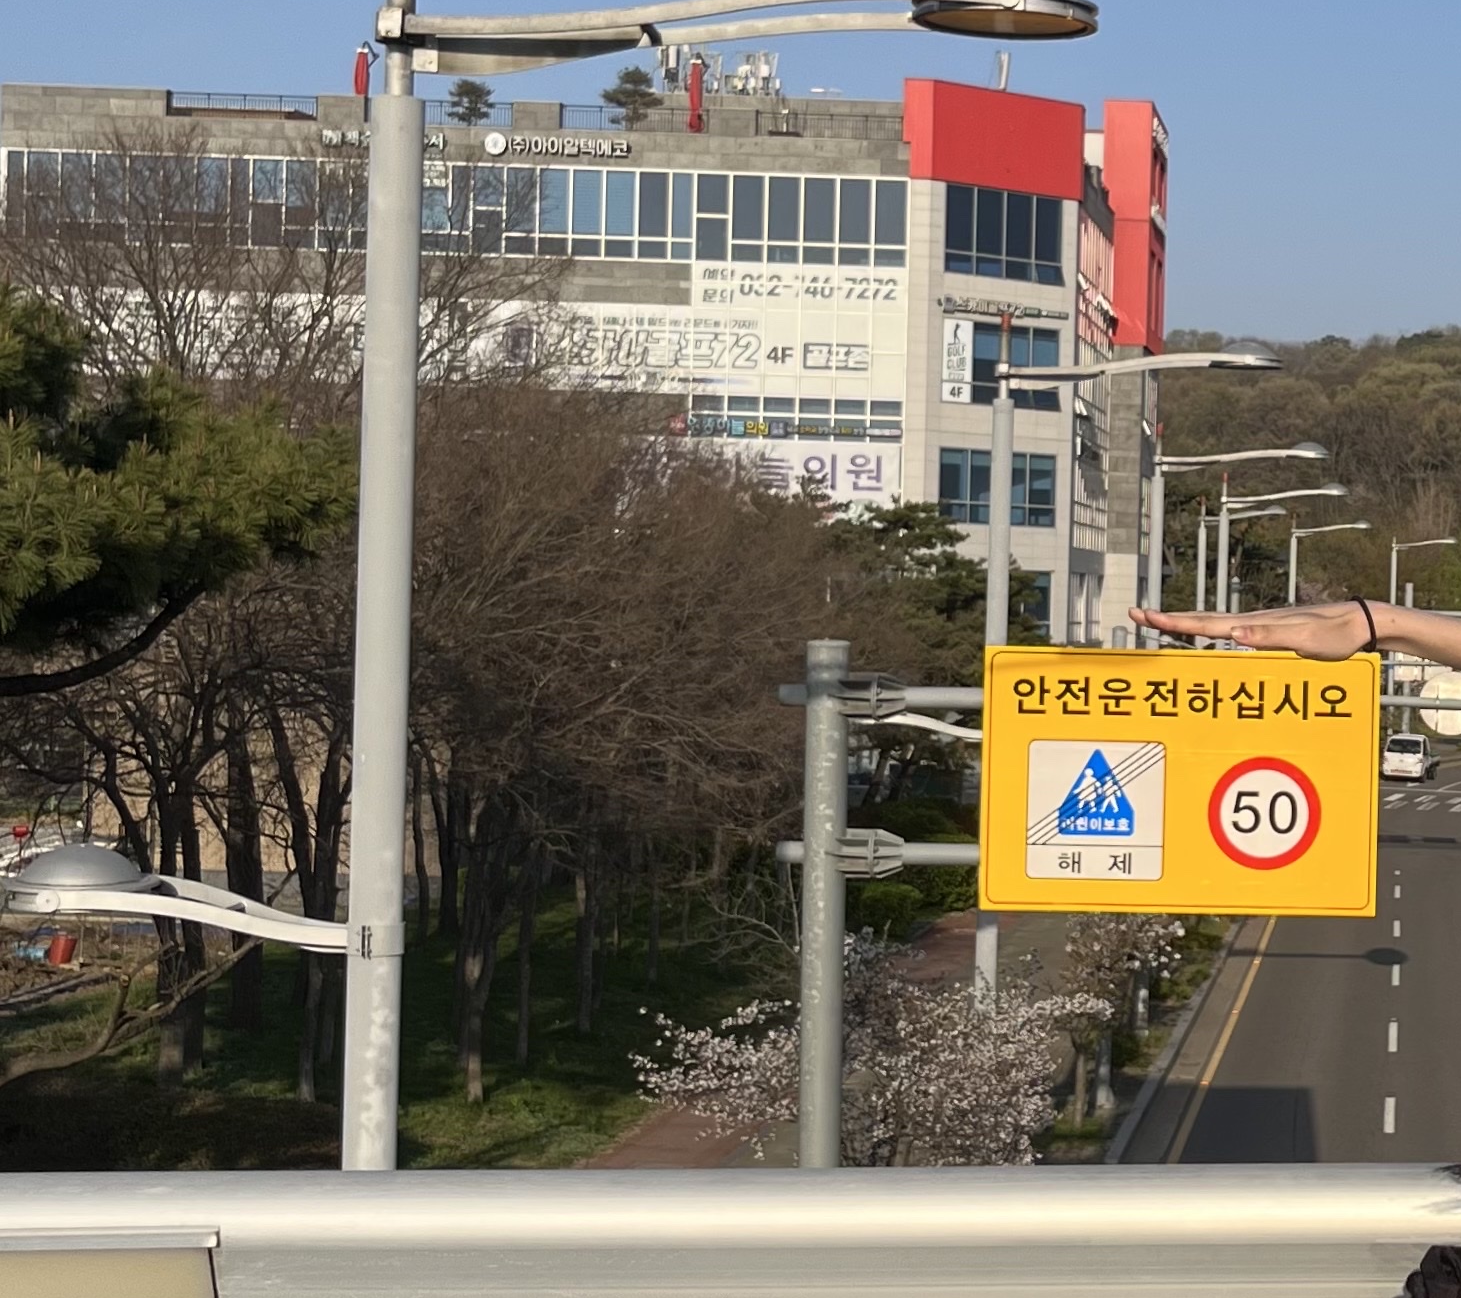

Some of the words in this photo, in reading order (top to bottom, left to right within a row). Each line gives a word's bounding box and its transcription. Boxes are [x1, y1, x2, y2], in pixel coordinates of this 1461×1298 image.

[767, 346, 794, 364] 4F
[949, 386, 963, 399] 4F
[1013, 675, 1353, 720] 안전운전하십시오
[1231, 791, 1298, 835] 50
